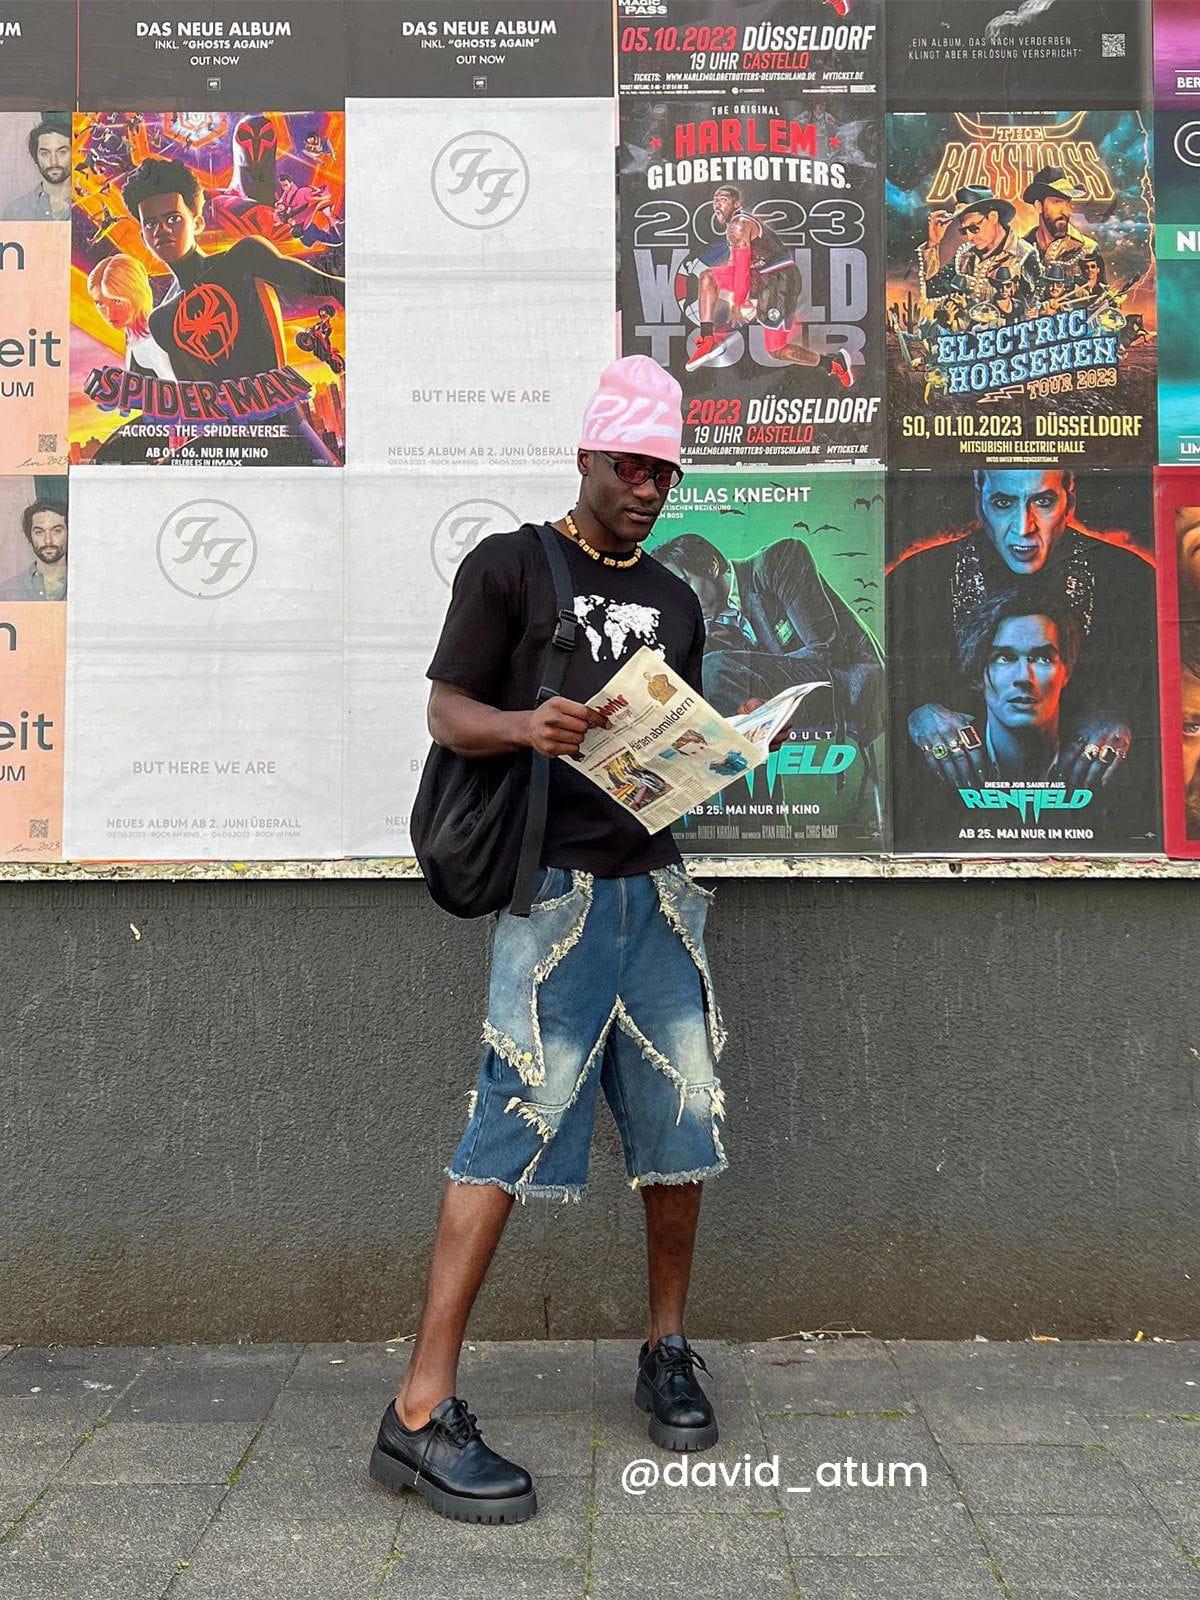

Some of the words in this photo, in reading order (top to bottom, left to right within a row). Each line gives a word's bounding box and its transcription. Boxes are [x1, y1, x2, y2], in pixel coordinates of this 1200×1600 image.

[625, 6, 668, 15] PASS
[136, 22, 172, 37] DAS
[178, 22, 223, 37] NEUE
[229, 21, 292, 36] ALBUM
[402, 22, 438, 36] DAS
[444, 21, 489, 36] NEUE
[495, 20, 557, 35] ALBUM
[421, 40, 445, 49] INKL.
[448, 39, 496, 48] "GHOSTS
[500, 38, 540, 48] AGAIN"
[621, 26, 738, 52] 05.10.2023
[742, 22, 875, 51] DÜSSELDORF
[969, 37, 986, 47] DAS
[990, 37, 1015, 46] NACH
[1018, 36, 1071, 46] VERDERBEN
[155, 40, 180, 49] INKL.
[183, 39, 231, 49] "GHOSTS
[233, 39, 274, 49] AGAIN"
[190, 56, 211, 66] OUT
[213, 56, 240, 66] NOW
[456, 55, 476, 64] OUT
[480, 55, 505, 64] NOW
[689, 53, 705, 70] 19
[709, 53, 740, 70] UHR
[743, 52, 809, 70] CASTELLO
[909, 50, 940, 60] KLINGT
[945, 50, 968, 59] ABER
[972, 49, 1018, 59] ERLÖSUNG
[822, 72, 864, 80] MYTICKET.DE
[711, 107, 730, 115] THE
[733, 106, 780, 116] ORIGINAL
[675, 118, 818, 159] HARLEM
[996, 126, 1044, 141] THE
[647, 156, 851, 191] GLOBETROTTERS.
[937, 308, 1088, 365] ELECTRIC
[0, 328, 61, 367] eit
[948, 335, 1118, 393] HORSEMEN
[1, 382, 33, 397] UM
[1027, 376, 1073, 400] TOUR
[1077, 369, 1118, 390] 2023
[84, 366, 313, 420] SPIDER-MAN
[412, 390, 443, 403] BUT
[447, 390, 486, 402] HERE
[491, 390, 516, 402] WE
[520, 390, 551, 402] ARE
[746, 395, 881, 424] DÜSSELDORF
[122, 425, 170, 437] ACROSS
[175, 425, 198, 437] THE
[203, 424, 287, 437] SPIDER-VERSE
[902, 415, 931, 440] SO,
[934, 415, 1022, 437] 01.10.2023
[1036, 412, 1142, 437] DÜSSELDORF
[694, 426, 708, 444] 19
[713, 426, 743, 443] UHR
[746, 425, 814, 444] CASTELLO
[146, 447, 161, 458] AB
[162, 447, 180, 458] 01.
[181, 447, 198, 458] 06.
[201, 447, 224, 458] NUR
[226, 447, 240, 458] IM
[242, 447, 268, 458] KINO
[388, 447, 424, 456] NEUES
[427, 447, 466, 456] ALBUM
[469, 447, 484, 456] AB
[487, 447, 497, 456] 2.
[499, 447, 524, 456] JUNI
[527, 444, 577, 456] ÜBERALL
[827, 445, 869, 454] MYTICKET.DE
[960, 441, 1013, 453] MITSUBISHI
[1014, 441, 1056, 453] ELECTRIC
[1057, 440, 1086, 453] HALLE
[667, 488, 728, 503] CULAS
[735, 487, 811, 503] KNECHT
[649, 697, 694, 740] abmildern
[789, 732, 832, 740] OULT
[132, 762, 164, 774] BUT
[168, 761, 210, 774] HERE
[214, 762, 240, 774] WE
[244, 762, 276, 774] ARE
[688, 805, 703, 815] AB
[707, 805, 723, 815] 25.
[726, 805, 746, 815] MAI
[750, 805, 773, 815] NUR
[776, 805, 788, 814] IM
[793, 804, 820, 814] KINO
[959, 789, 1094, 824] RENFIELD
[107, 818, 144, 829] NEUES
[148, 818, 188, 828] ALBUM
[191, 818, 206, 828] AB
[209, 818, 219, 828] 2.
[222, 818, 248, 828] JUNI
[250, 816, 301, 828] ÜBERALL
[386, 816, 408, 826] NEU
[959, 829, 975, 840] AB
[977, 829, 994, 840] 25.
[997, 829, 1018, 839] MAI
[1020, 829, 1046, 839] NUR
[1048, 829, 1063, 839] IM
[1065, 829, 1094, 839] KINO
